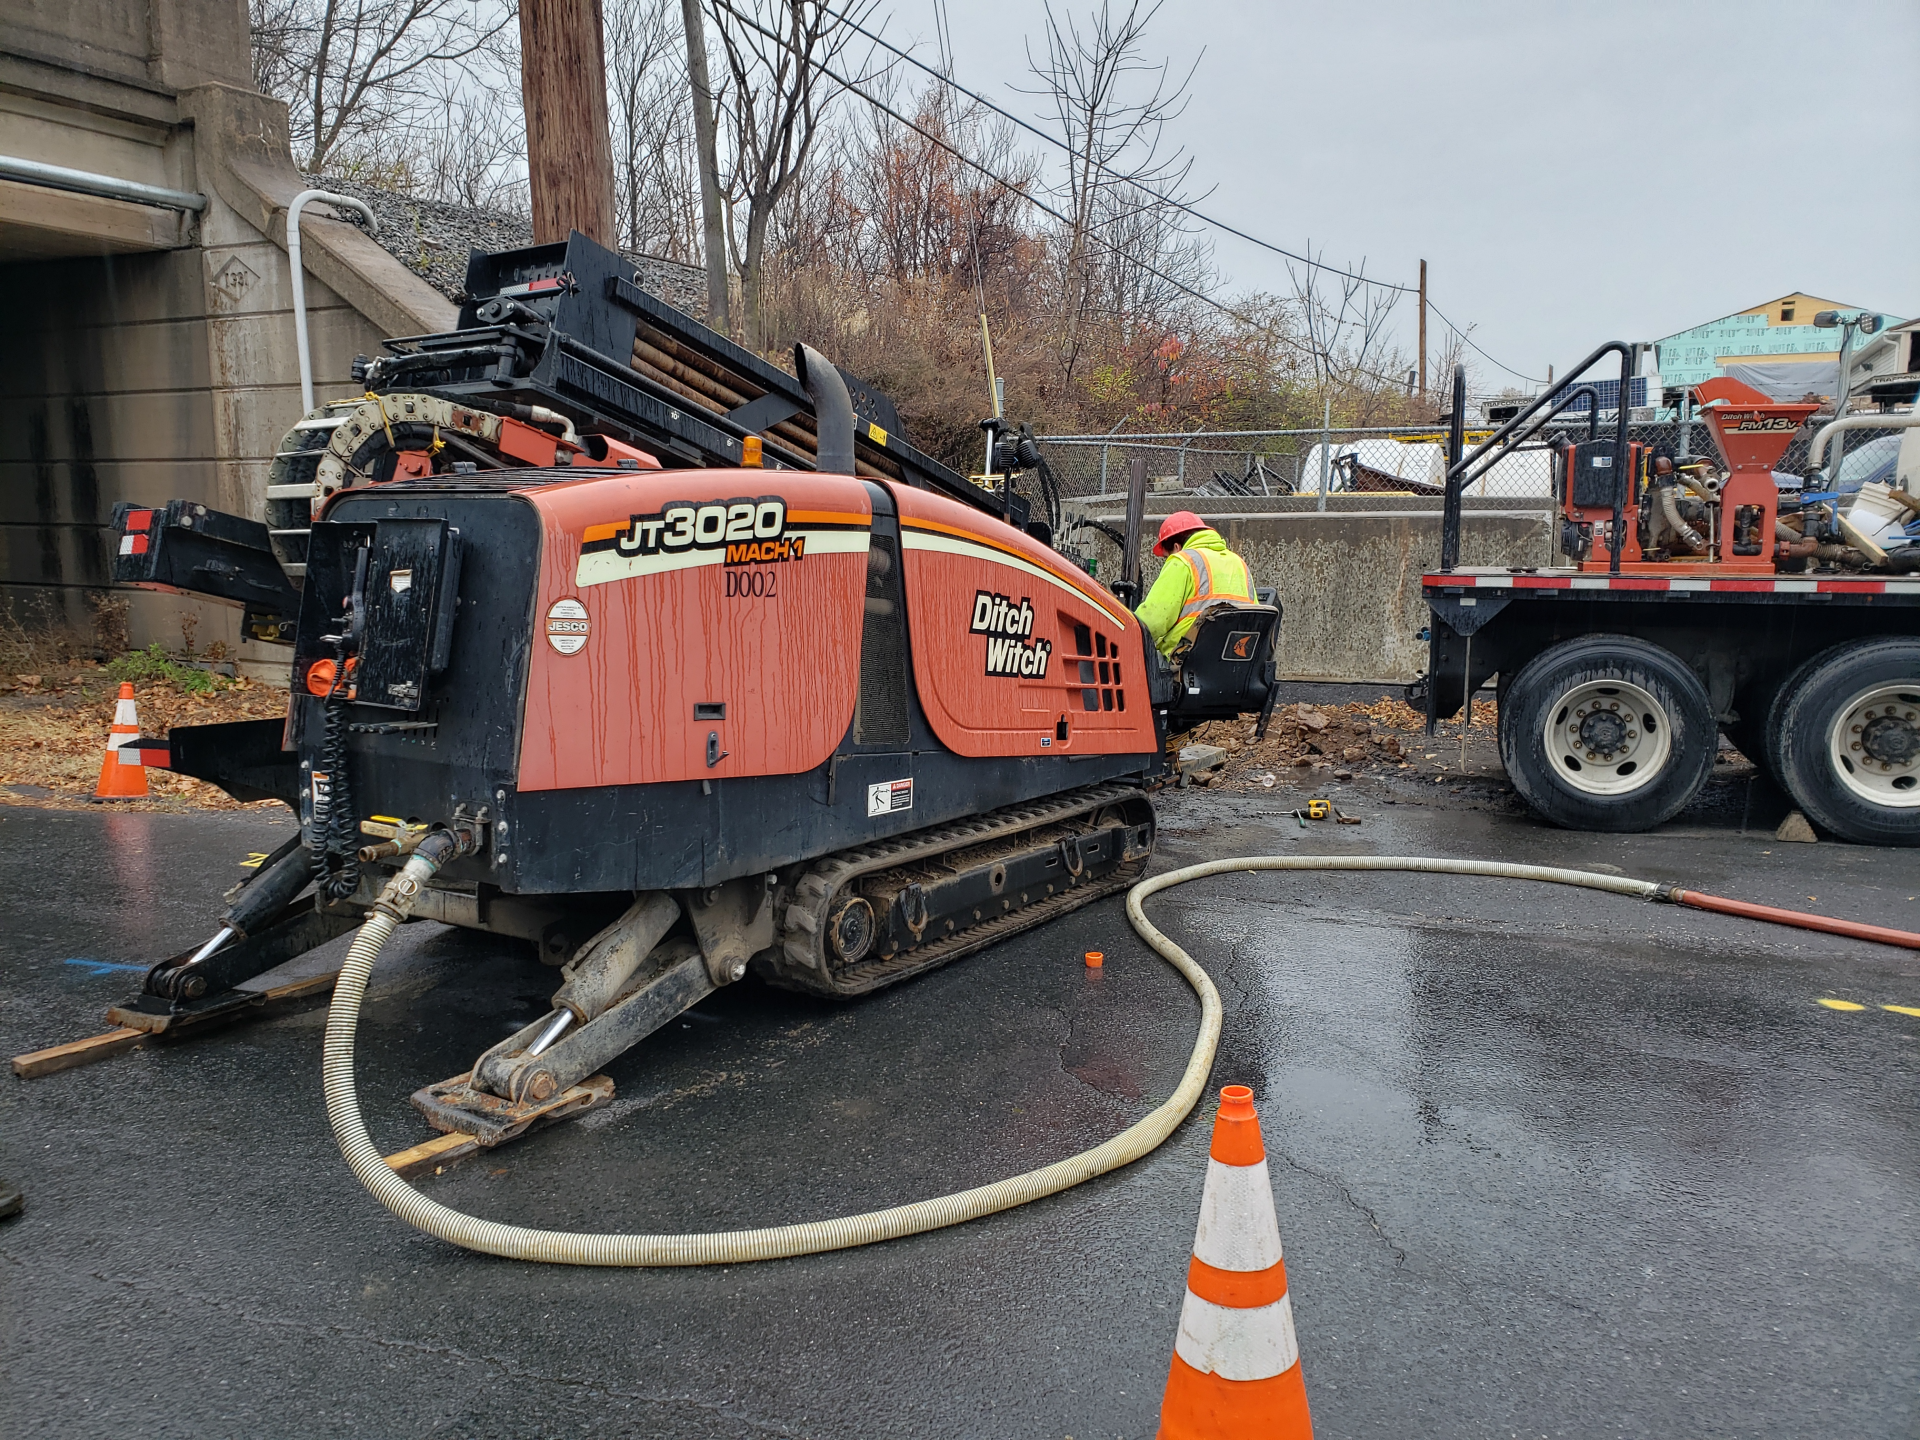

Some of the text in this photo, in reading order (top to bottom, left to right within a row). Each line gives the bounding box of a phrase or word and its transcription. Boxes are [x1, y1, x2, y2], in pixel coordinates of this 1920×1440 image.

[620, 502, 784, 550] JT3020
[725, 571, 776, 598] D002
[549, 621, 588, 632] JESCO
[972, 594, 1033, 635] Ditch
